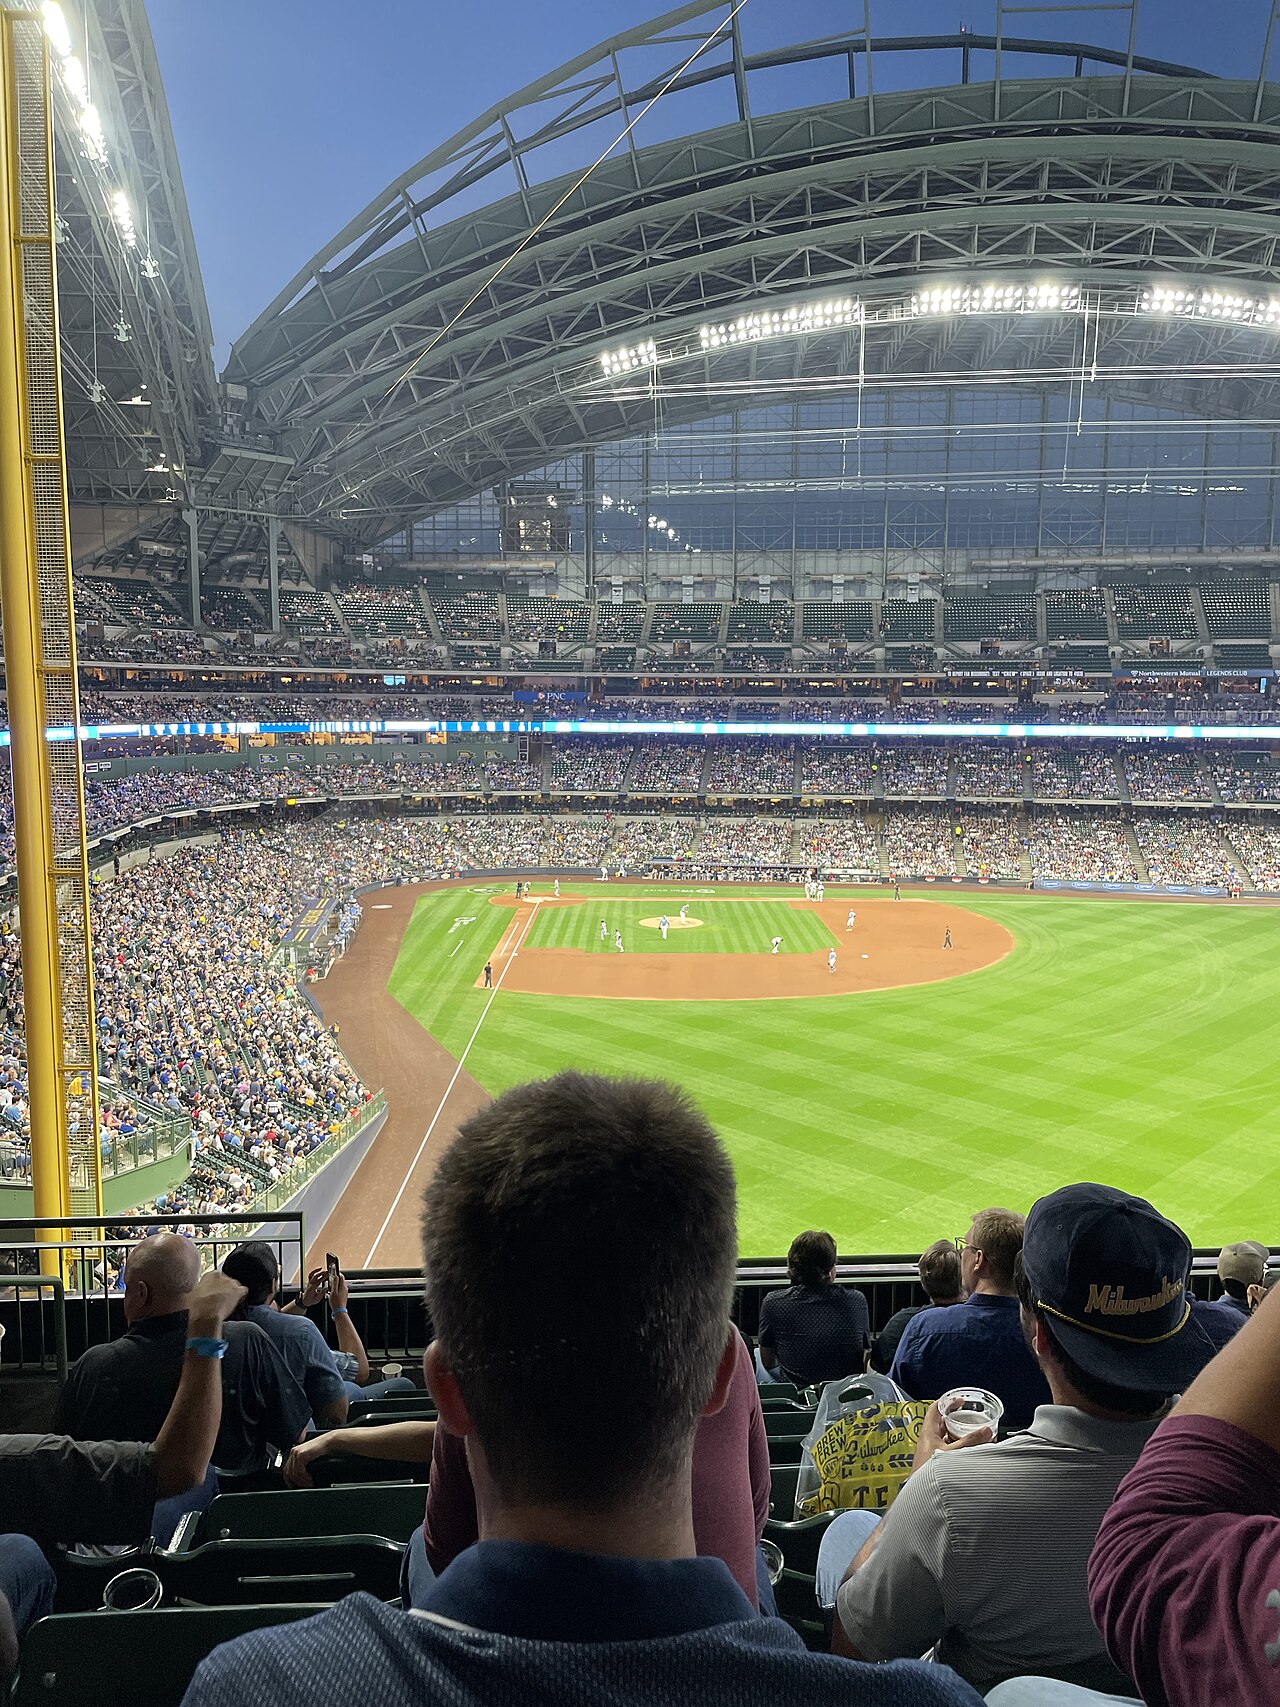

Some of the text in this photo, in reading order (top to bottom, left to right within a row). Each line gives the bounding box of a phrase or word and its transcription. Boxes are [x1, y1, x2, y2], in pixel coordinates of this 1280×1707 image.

[547, 692, 566, 700] PNC
[816, 1422, 844, 1456] BREW
[818, 1434, 847, 1465] CREW
